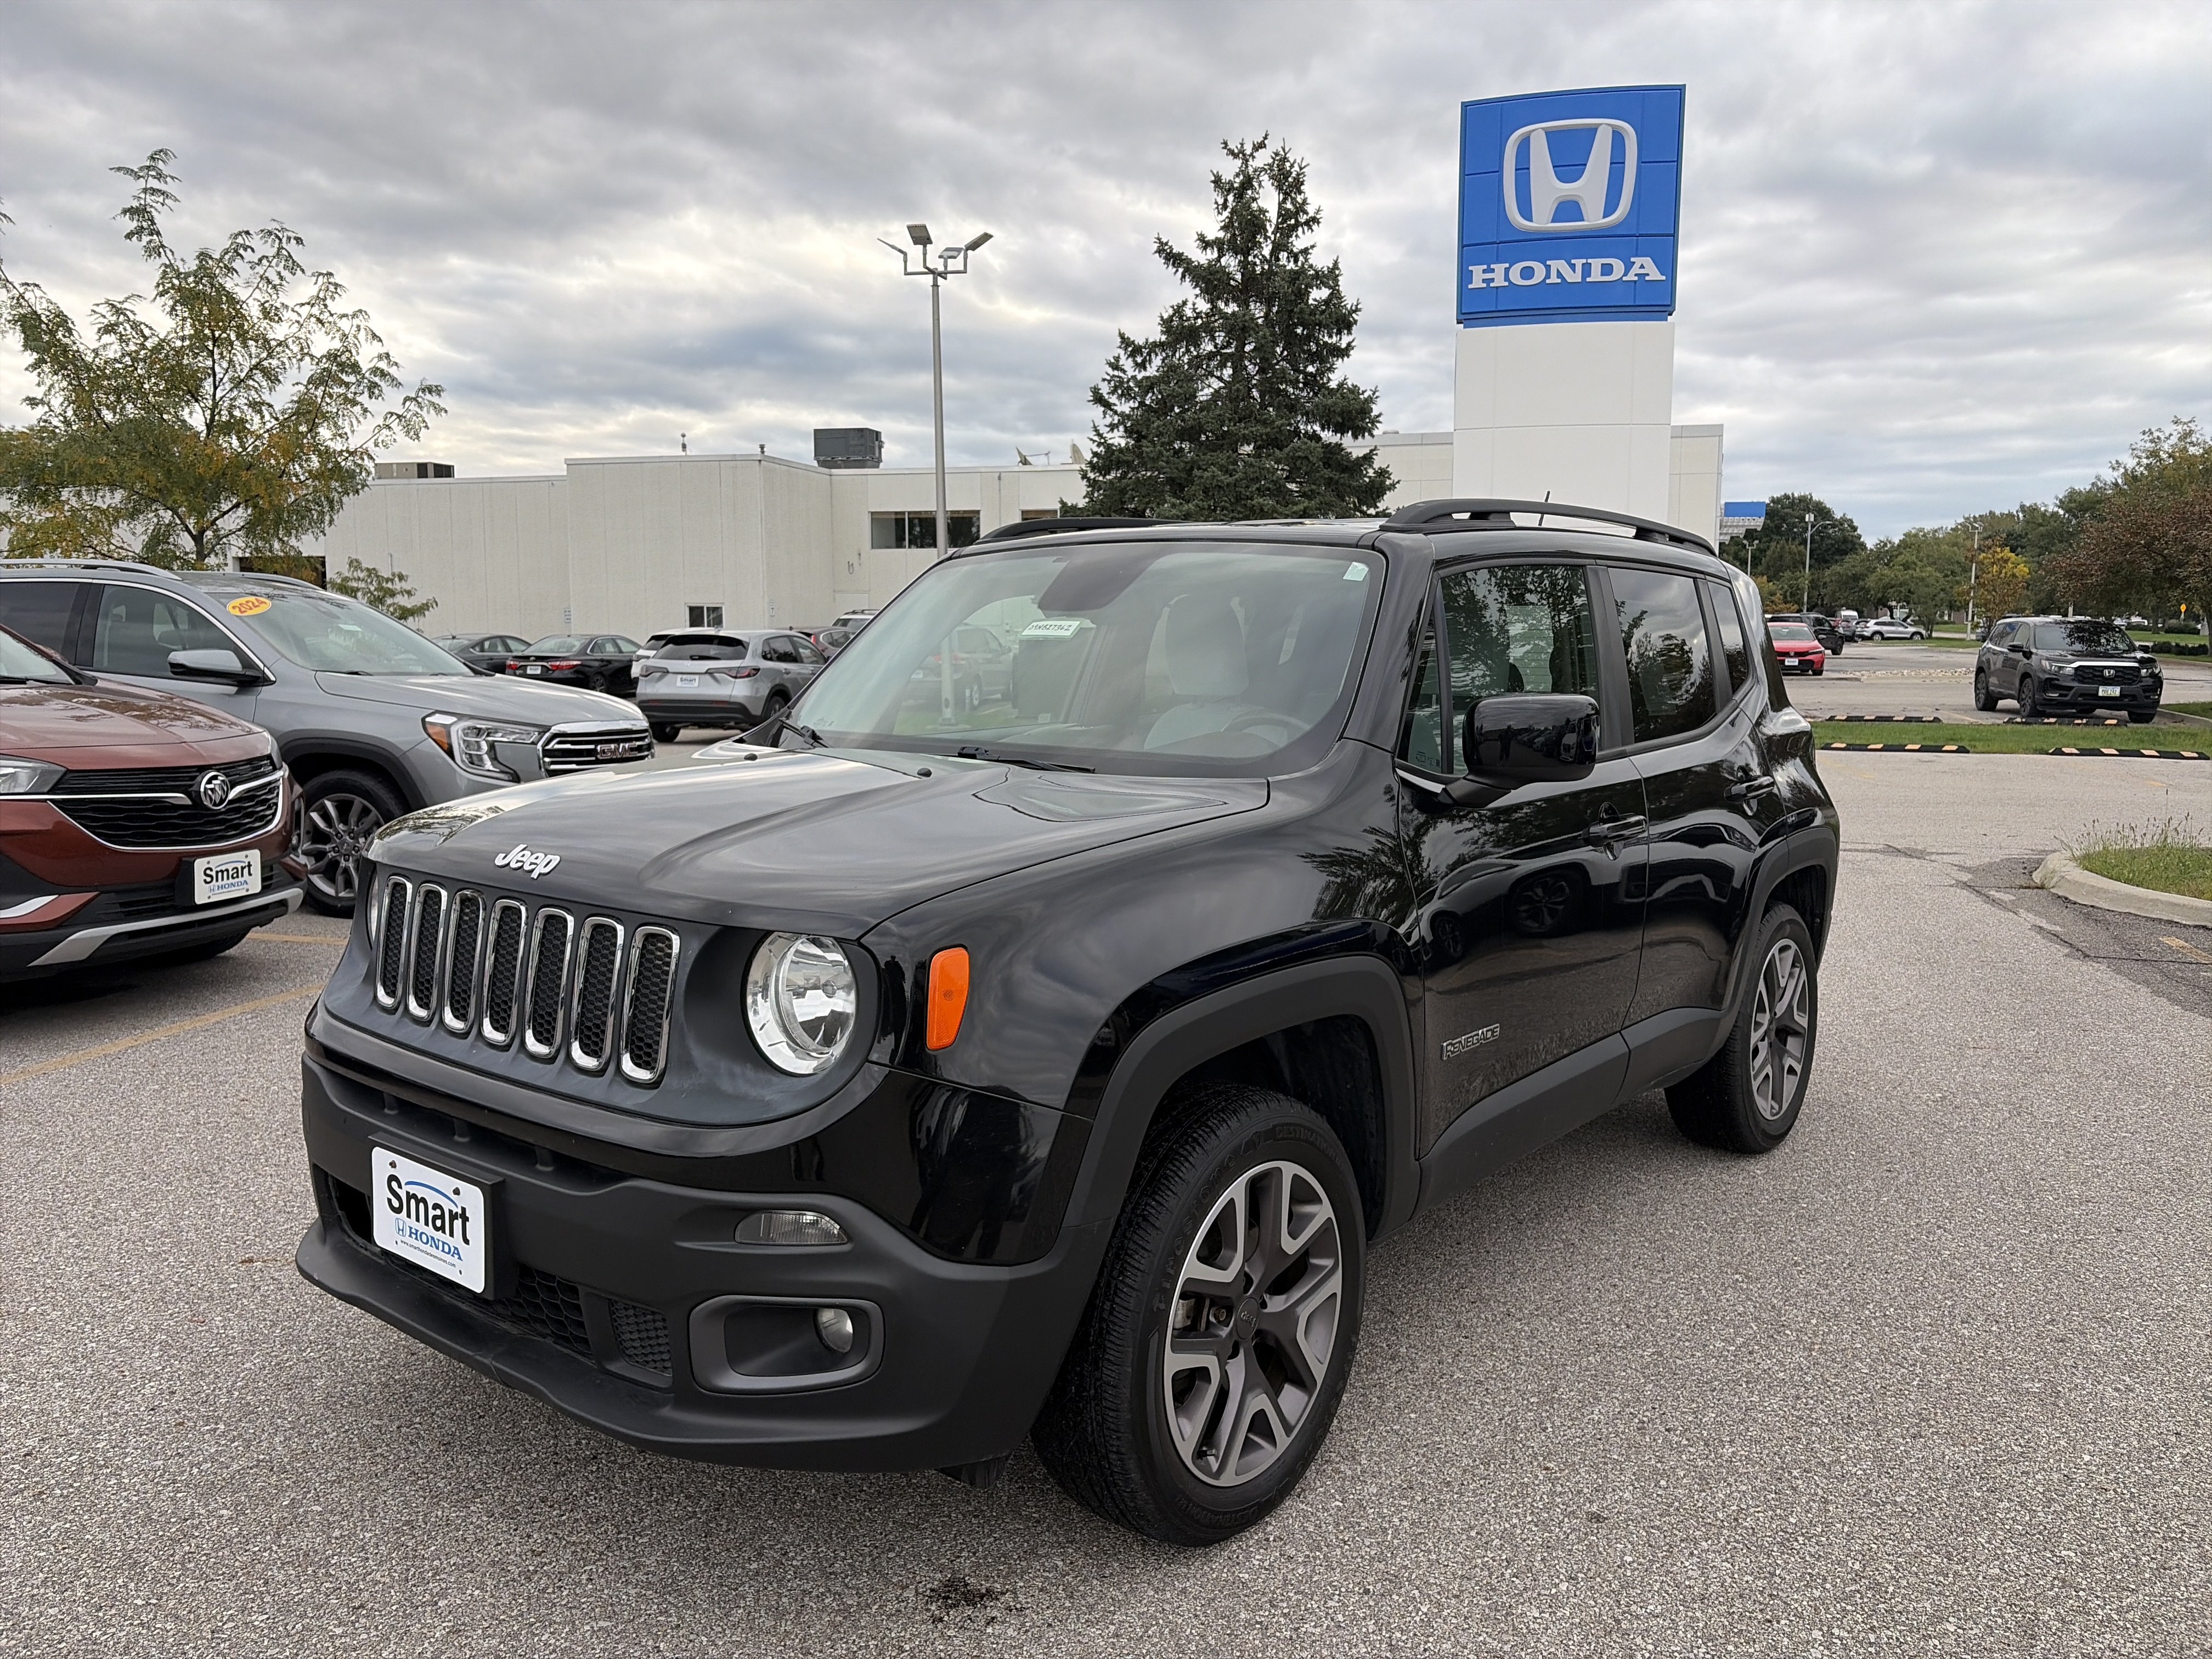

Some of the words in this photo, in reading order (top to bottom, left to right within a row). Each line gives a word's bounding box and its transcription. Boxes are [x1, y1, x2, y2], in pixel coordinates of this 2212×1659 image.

[1468, 257, 1666, 289] HONDA
[232, 597, 268, 614] 2024
[597, 741, 638, 759] GMC
[203, 861, 252, 884] Smart
[494, 844, 562, 880] Jeep
[217, 879, 248, 891] HONDA
[1442, 1023, 1500, 1060] RENEGADE
[386, 1174, 470, 1246] Smart
[400, 1239, 456, 1268] www.smarthondadesmoines.com
[408, 1226, 464, 1262] HONDA
